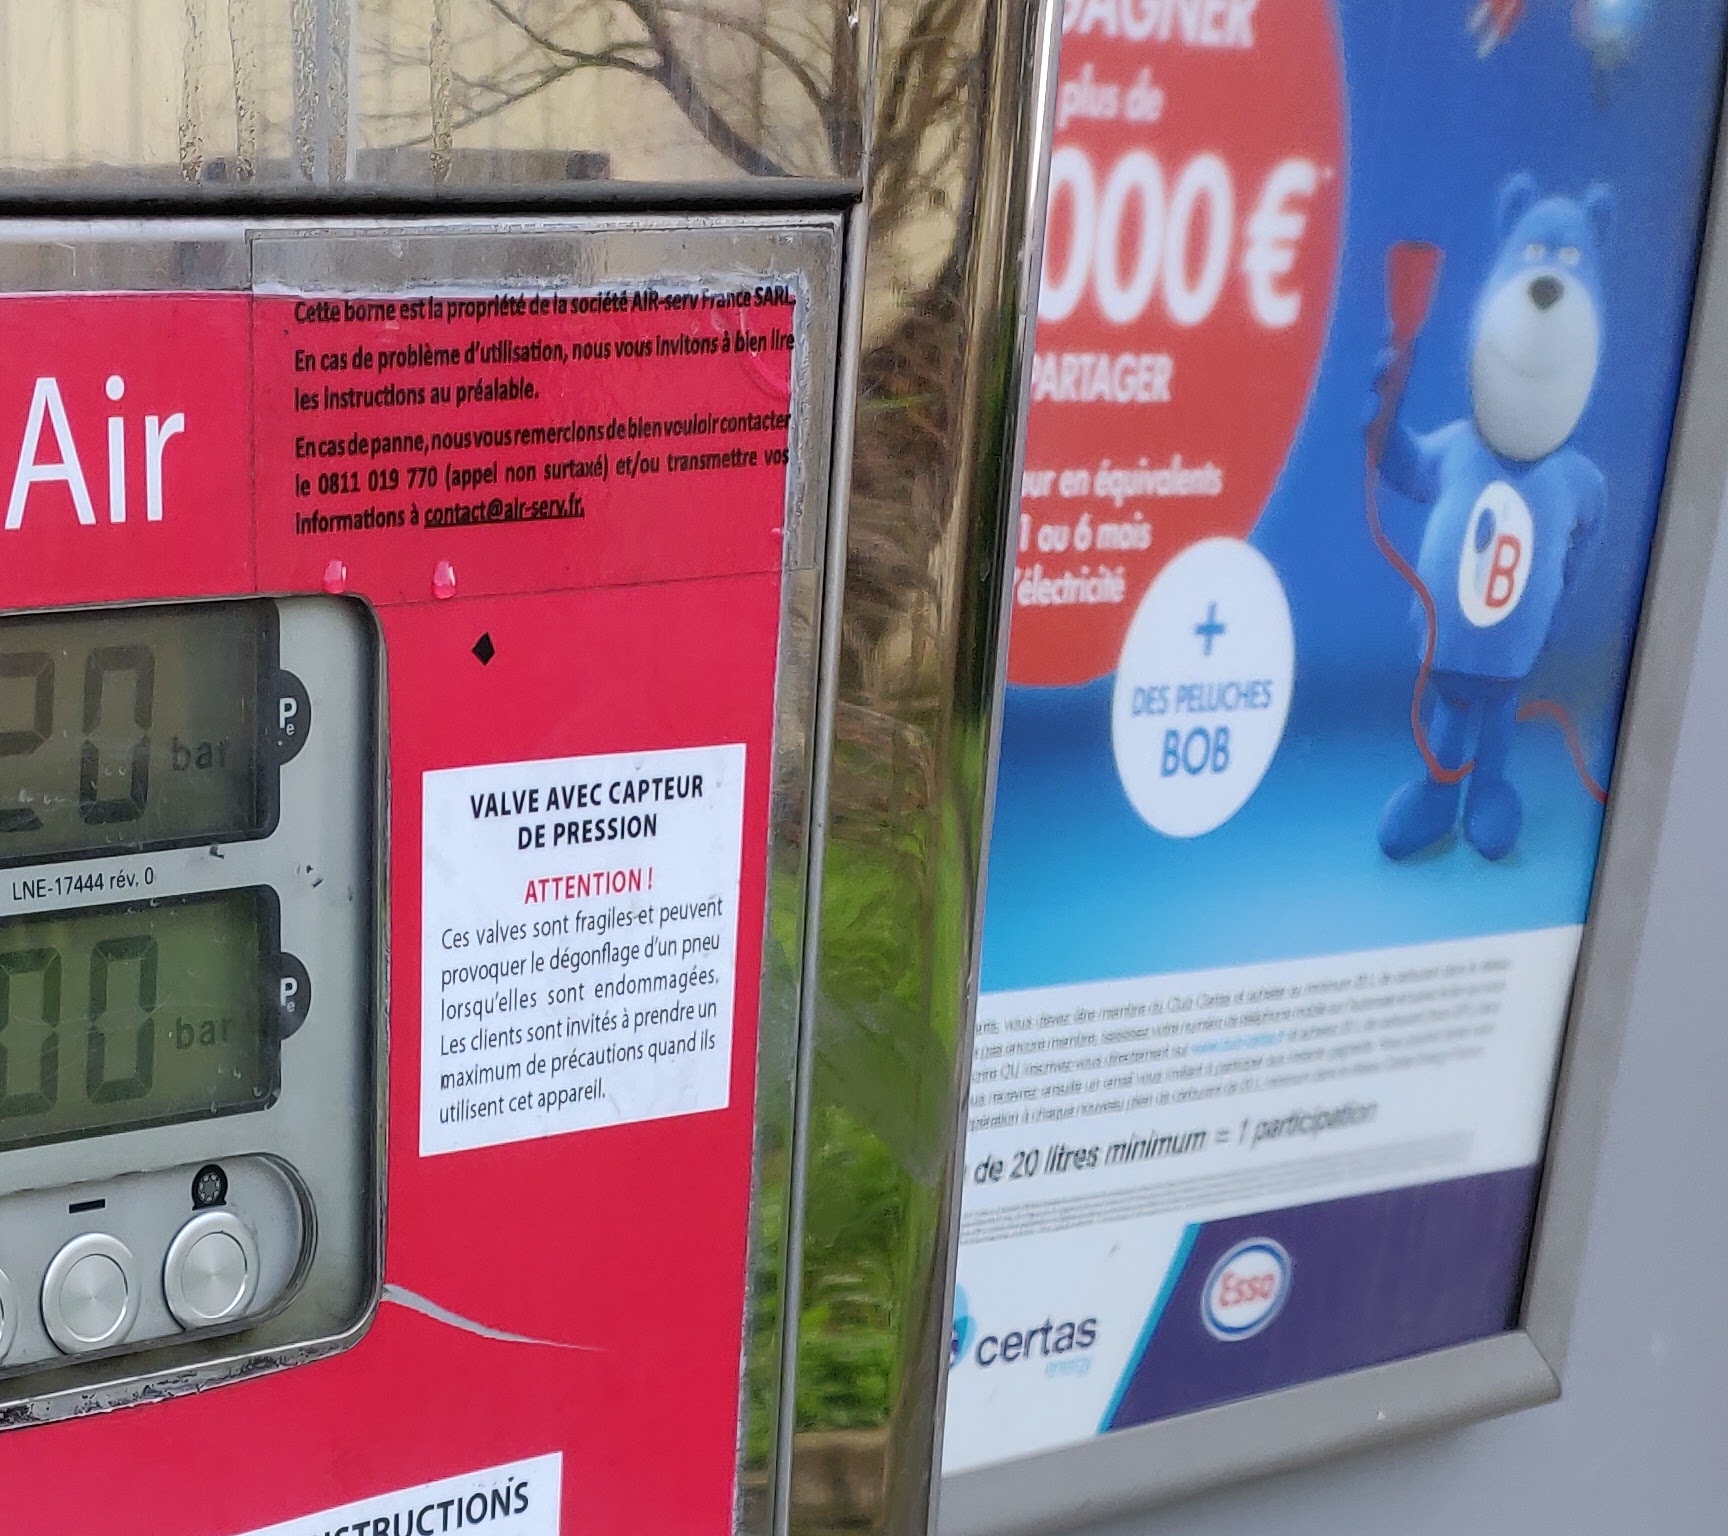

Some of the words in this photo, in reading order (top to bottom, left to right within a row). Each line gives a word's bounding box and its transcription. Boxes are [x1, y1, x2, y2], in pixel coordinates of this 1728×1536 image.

[294, 388, 319, 412] les
[323, 383, 425, 410] instructions
[429, 385, 451, 404] au
[455, 377, 538, 408] préalable.
[4, 375, 185, 530] Air
[295, 473, 311, 497] le
[317, 470, 360, 495] 0811
[367, 467, 399, 492] 019
[406, 465, 437, 489] 770
[444, 461, 497, 492] (appel
[504, 464, 536, 482] non
[543, 454, 608, 481] surtaxé)
[615, 451, 659, 478] et/ou
[666, 447, 757, 472] transmettre
[763, 443, 790, 468] vos
[1485, 534, 1521, 608] B
[1132, 687, 1170, 716] DES
[1176, 680, 1273, 713] PELUCHES
[172, 736, 228, 772] bar
[1161, 727, 1232, 777] BOB
[470, 788, 539, 819] VALVE
[545, 782, 602, 811] AVEC
[608, 774, 703, 804] CAPTEUR
[517, 823, 545, 850] DE
[552, 812, 657, 846] PRESSION
[12, 872, 104, 902] LNE-17444
[109, 868, 140, 890] rév.
[145, 866, 155, 886] 0
[523, 867, 641, 904] ATTENTION
[647, 866, 652, 890] !
[441, 927, 469, 950] Ces
[475, 920, 527, 945] valves
[532, 914, 569, 938] sont
[574, 906, 633, 936] fragiles
[637, 905, 654, 925] et
[659, 897, 723, 929] peuvent
[175, 1013, 233, 1051] bar
[439, 1096, 504, 1124] utilisent
[508, 1090, 533, 1112] cet
[537, 1076, 605, 1112] appareil.
[974, 1160, 1003, 1184] de
[1009, 1149, 1039, 1181] 20
[1044, 1142, 1099, 1174] litres
[1105, 1128, 1207, 1165] minimum
[976, 1316, 1098, 1368] certas
